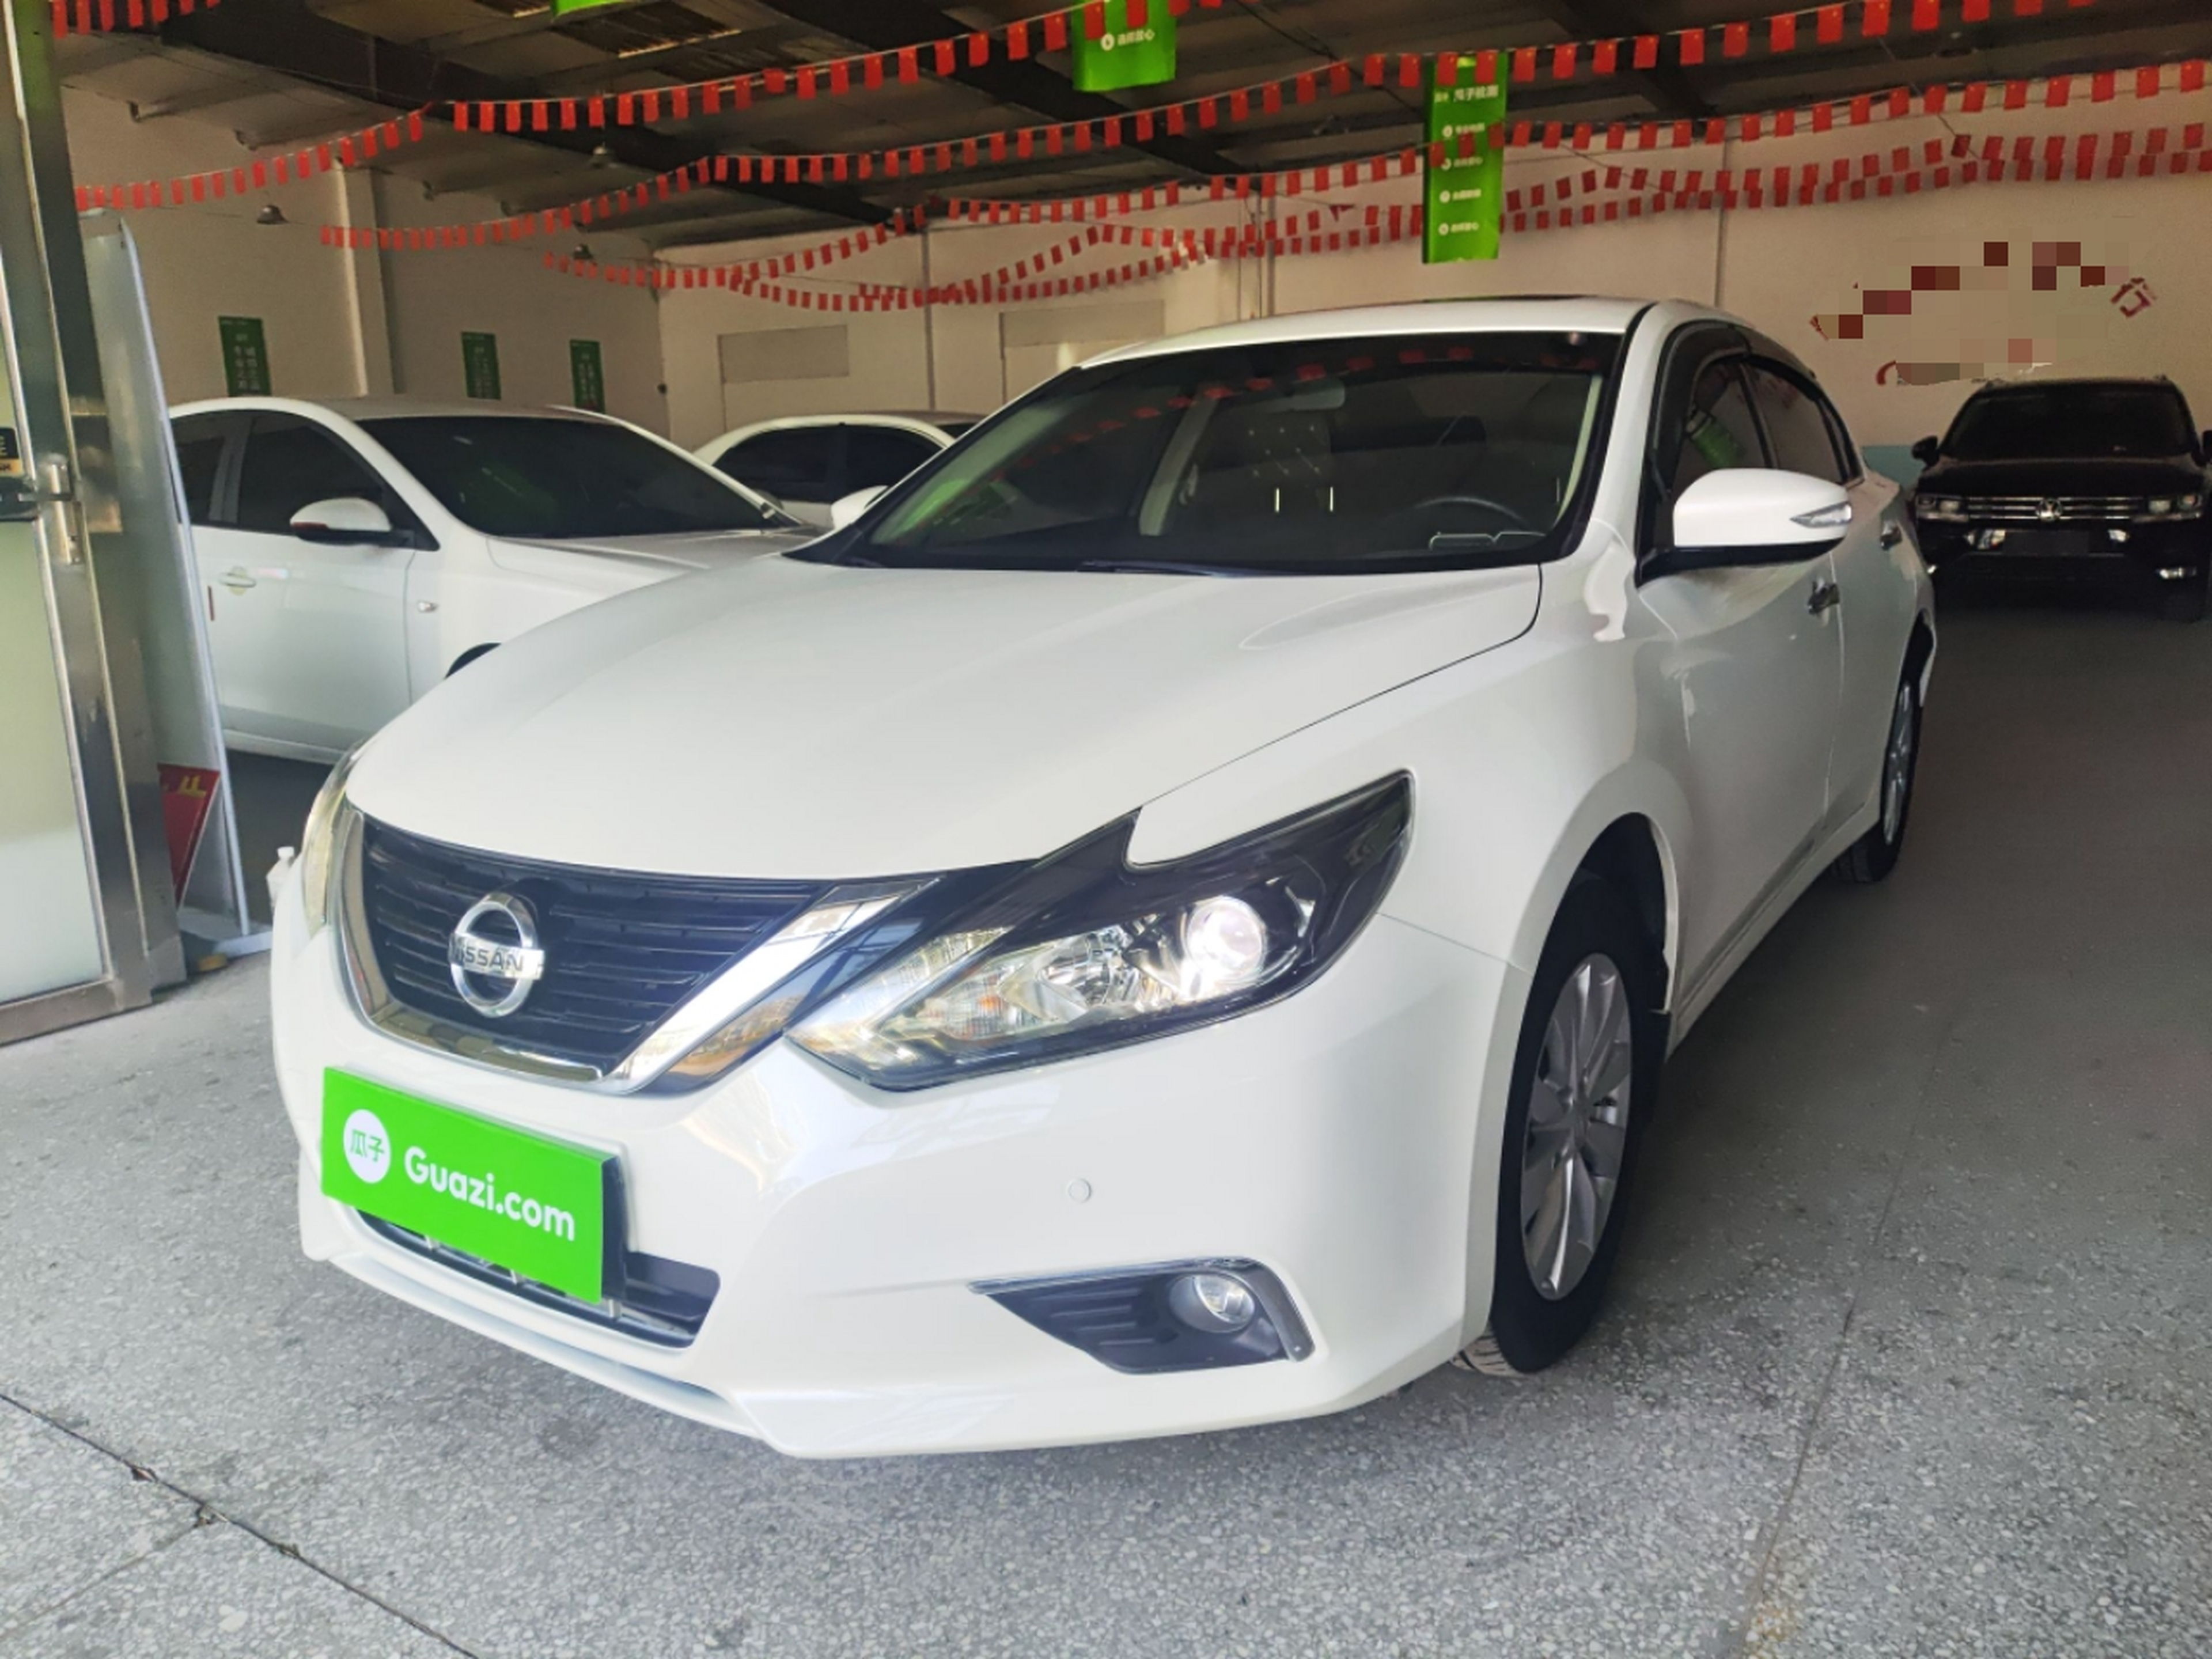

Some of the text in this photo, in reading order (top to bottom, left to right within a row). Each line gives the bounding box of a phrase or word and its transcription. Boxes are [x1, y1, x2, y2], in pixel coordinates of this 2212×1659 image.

[451, 935, 524, 972] NISSAN
[349, 1129, 385, 1162] 瓜子
[404, 1146, 575, 1241] Guazi.com
